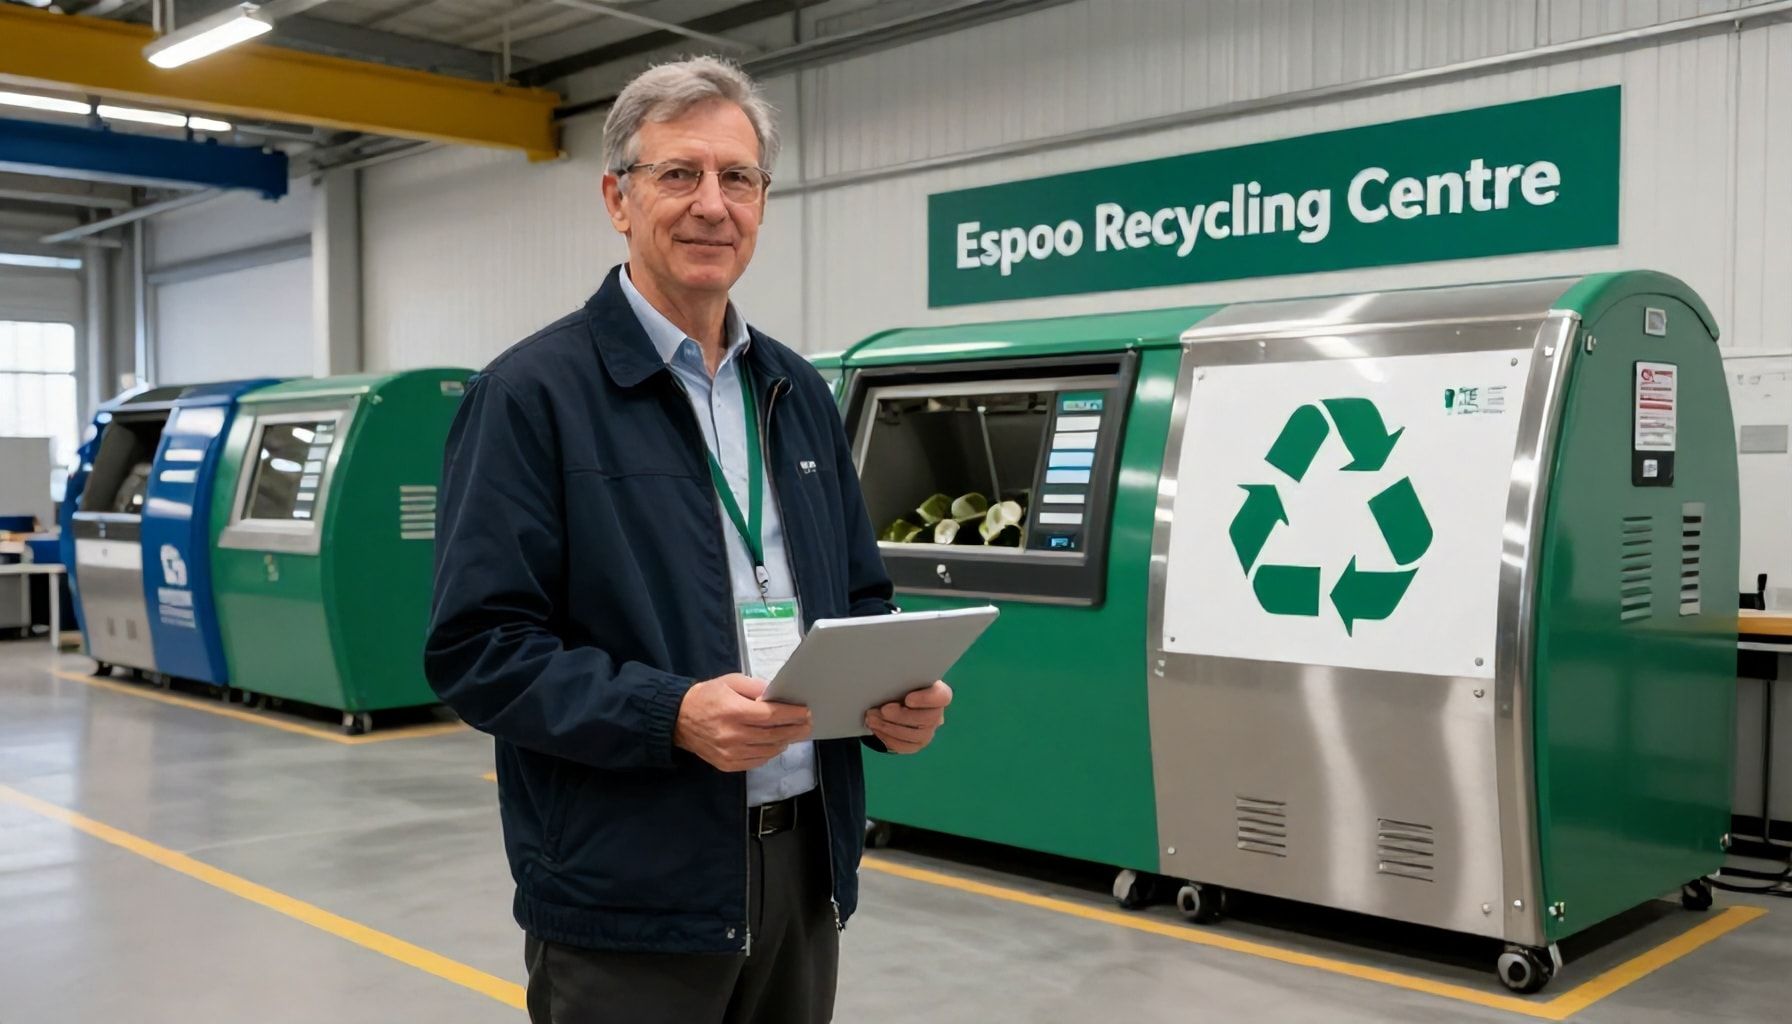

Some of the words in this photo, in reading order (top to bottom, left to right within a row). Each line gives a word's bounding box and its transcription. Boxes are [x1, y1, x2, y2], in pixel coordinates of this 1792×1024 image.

[956, 221, 1084, 276] Espoo
[1094, 181, 1332, 257] Recycling
[1347, 158, 1562, 223] Centre
